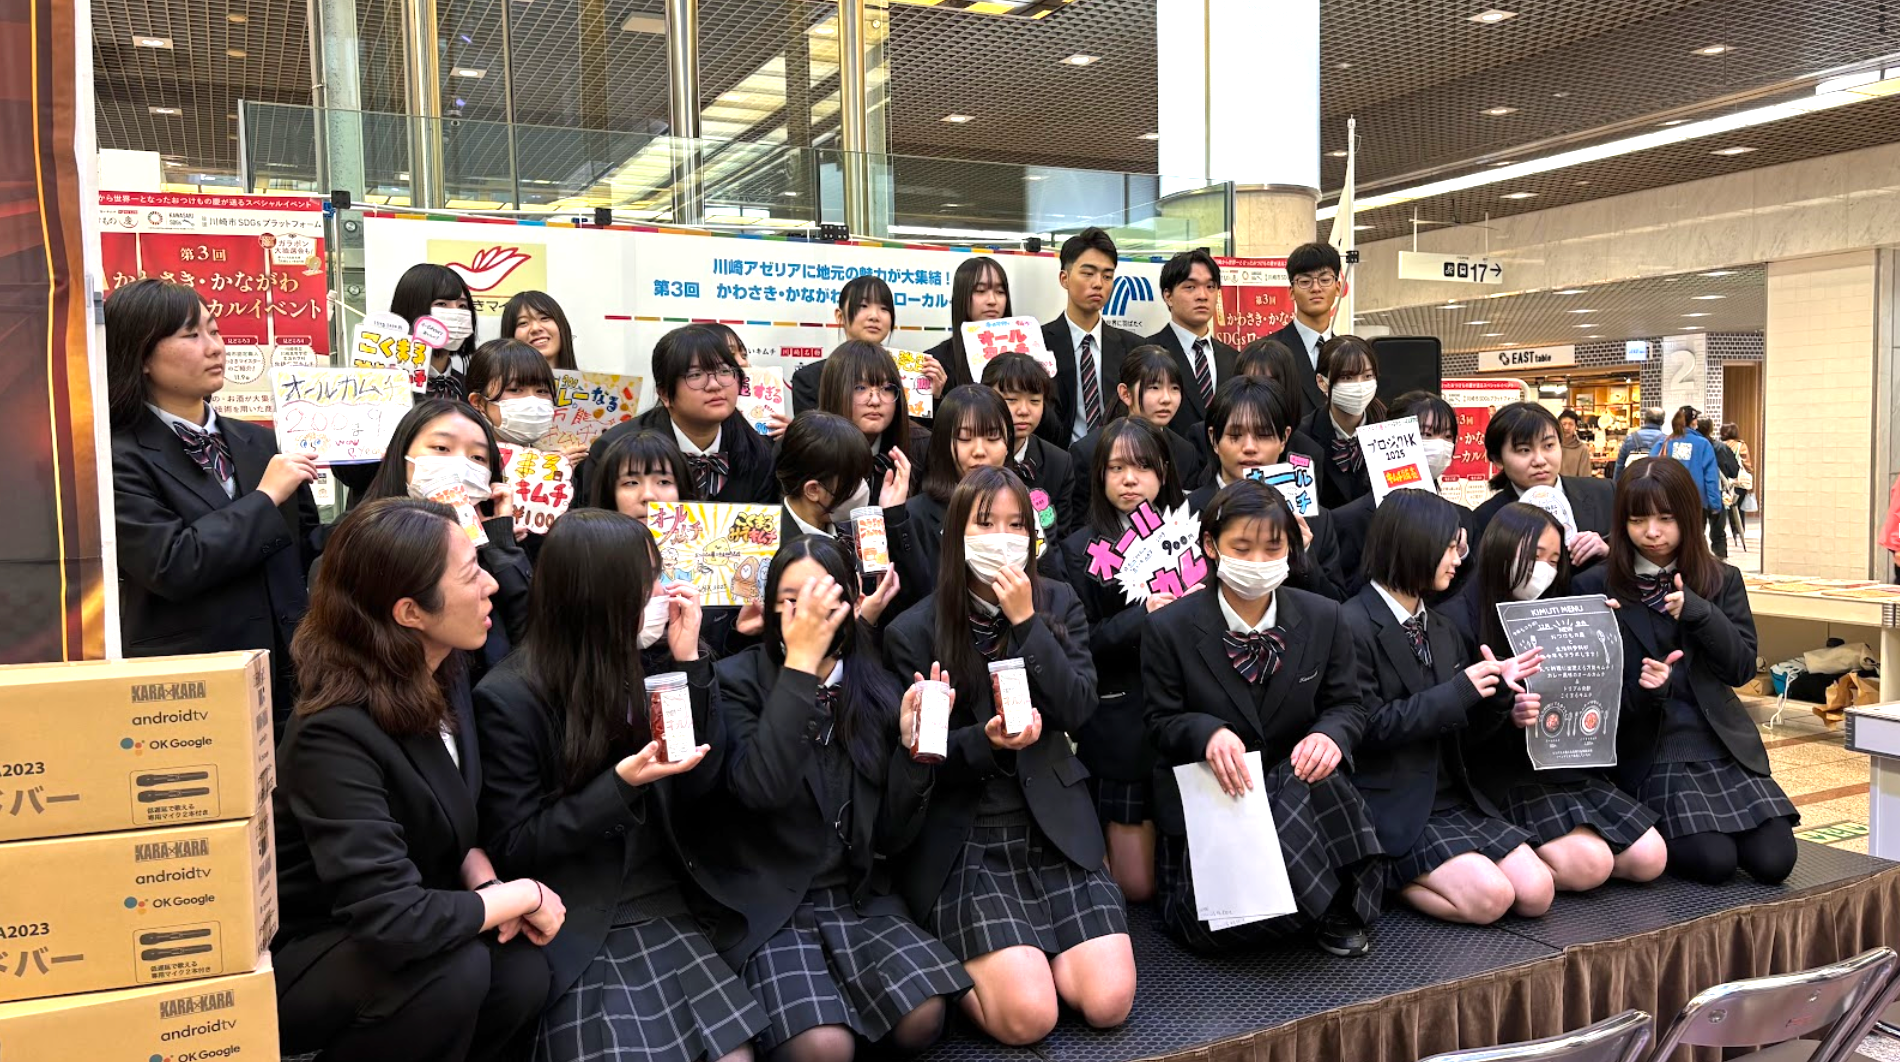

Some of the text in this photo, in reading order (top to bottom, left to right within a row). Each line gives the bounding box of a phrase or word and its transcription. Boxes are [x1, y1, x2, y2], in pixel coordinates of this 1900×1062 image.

[180, 245, 227, 262] 第3回
[1470, 264, 1487, 282] 17
[653, 279, 700, 299] 第3回
[473, 300, 506, 312] きマ
[1255, 293, 1277, 306] 第3回
[208, 299, 322, 320] カルイベント
[1216, 331, 1263, 346] SDGsロ
[358, 331, 427, 365] こくまろ
[1512, 351, 1552, 365] EAST table
[1670, 350, 1696, 390] 2
[555, 380, 619, 413] レーなる
[1457, 413, 1474, 426] 3回
[1385, 449, 1406, 461] 2025
[515, 479, 568, 508] キムチ
[1530, 604, 1584, 617] KIMUTI MENU
[149, 736, 213, 750] OK Google
[0, 761, 46, 777] 2023
[0, 785, 81, 817] バー
[152, 893, 215, 909] OK Google
[178, 1043, 241, 1062] OK Google
